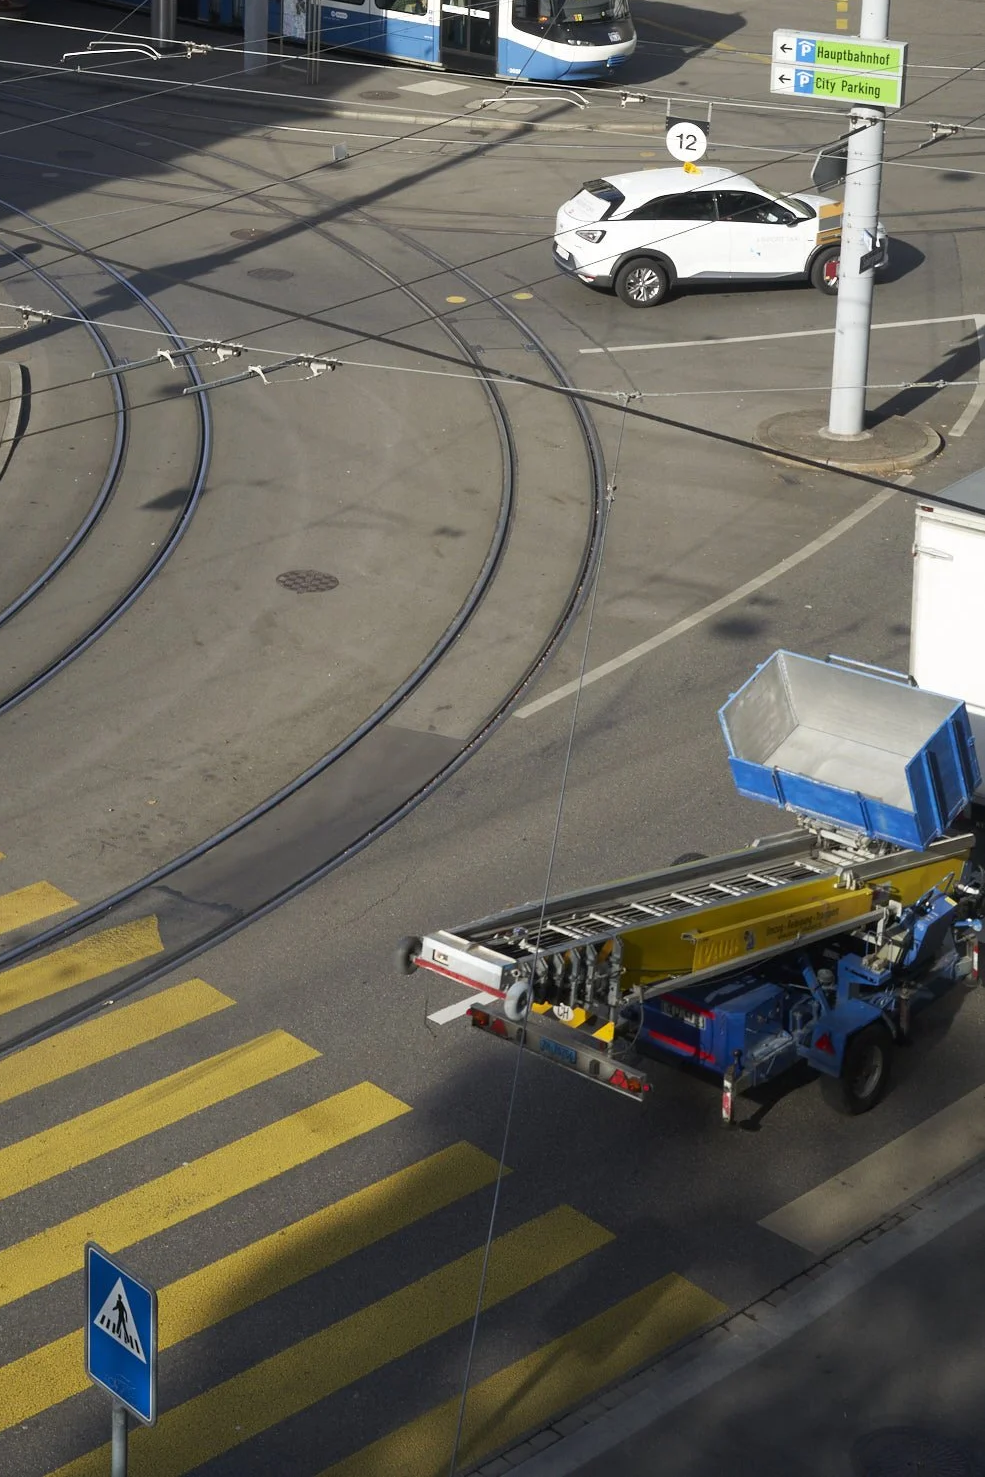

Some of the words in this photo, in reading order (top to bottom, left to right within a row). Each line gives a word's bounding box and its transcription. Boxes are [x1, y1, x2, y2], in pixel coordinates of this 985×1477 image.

[816, 46, 891, 66] Hauptbahnhof
[815, 77, 836, 94] City
[841, 80, 881, 99] Parking
[675, 133, 698, 152] 12
[557, 1006, 569, 1021] CH
